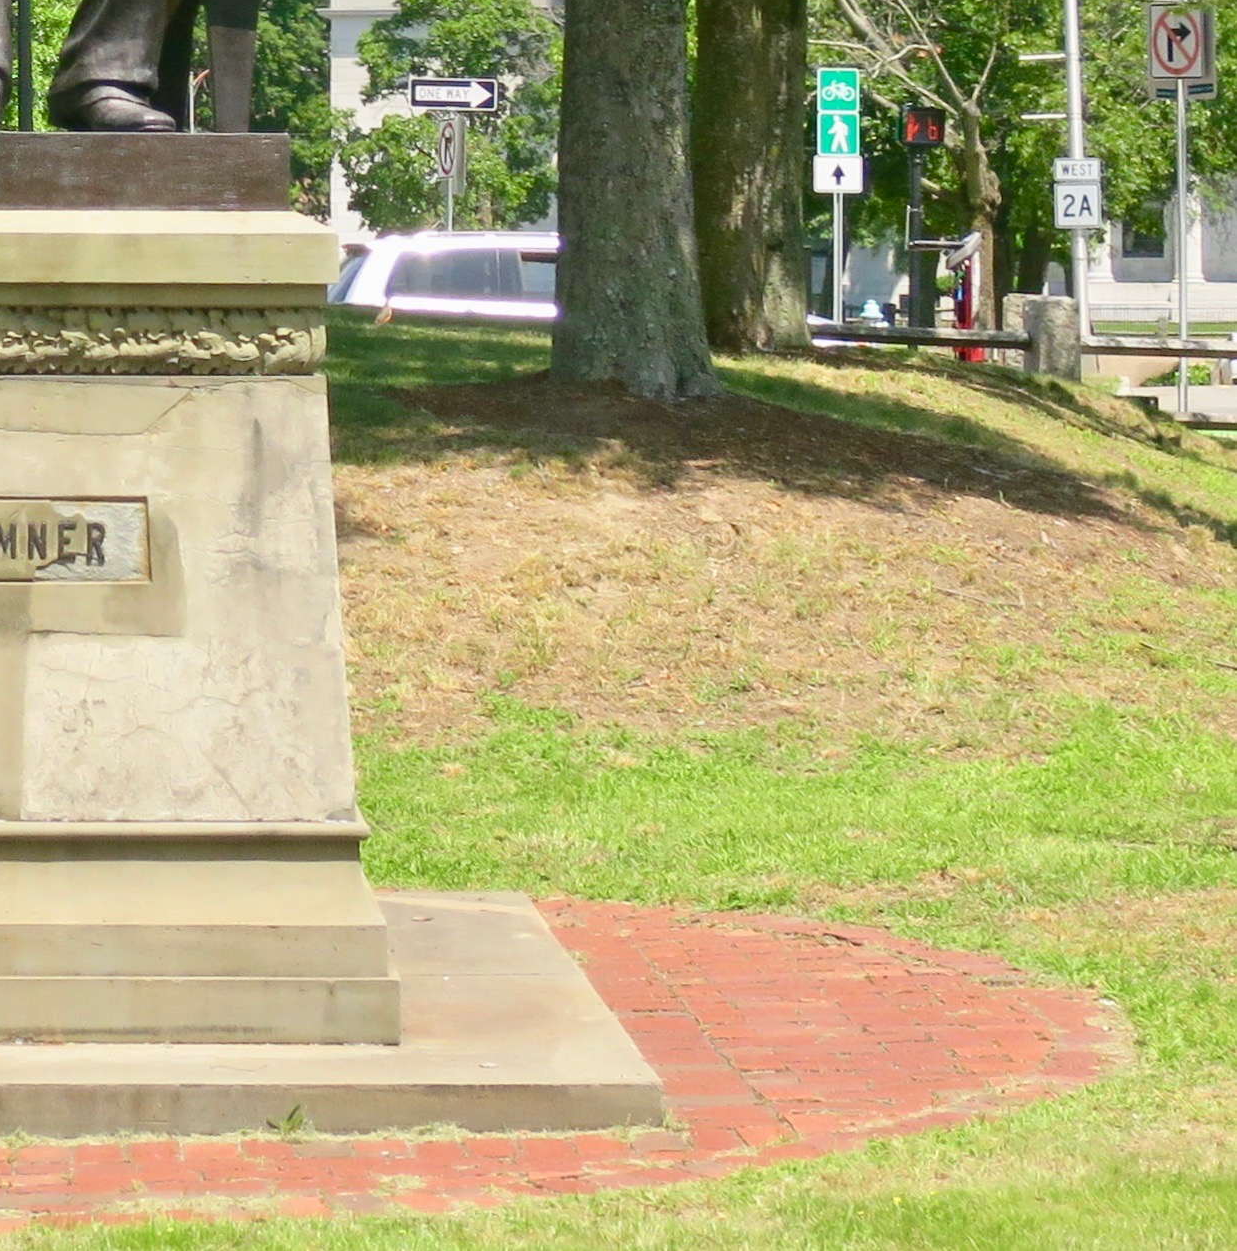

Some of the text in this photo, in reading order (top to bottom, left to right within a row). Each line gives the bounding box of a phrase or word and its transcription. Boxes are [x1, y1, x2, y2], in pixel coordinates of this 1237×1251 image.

[418, 87, 470, 101] ONE WAY
[1061, 164, 1093, 176] WEST
[1063, 194, 1092, 217] 2A
